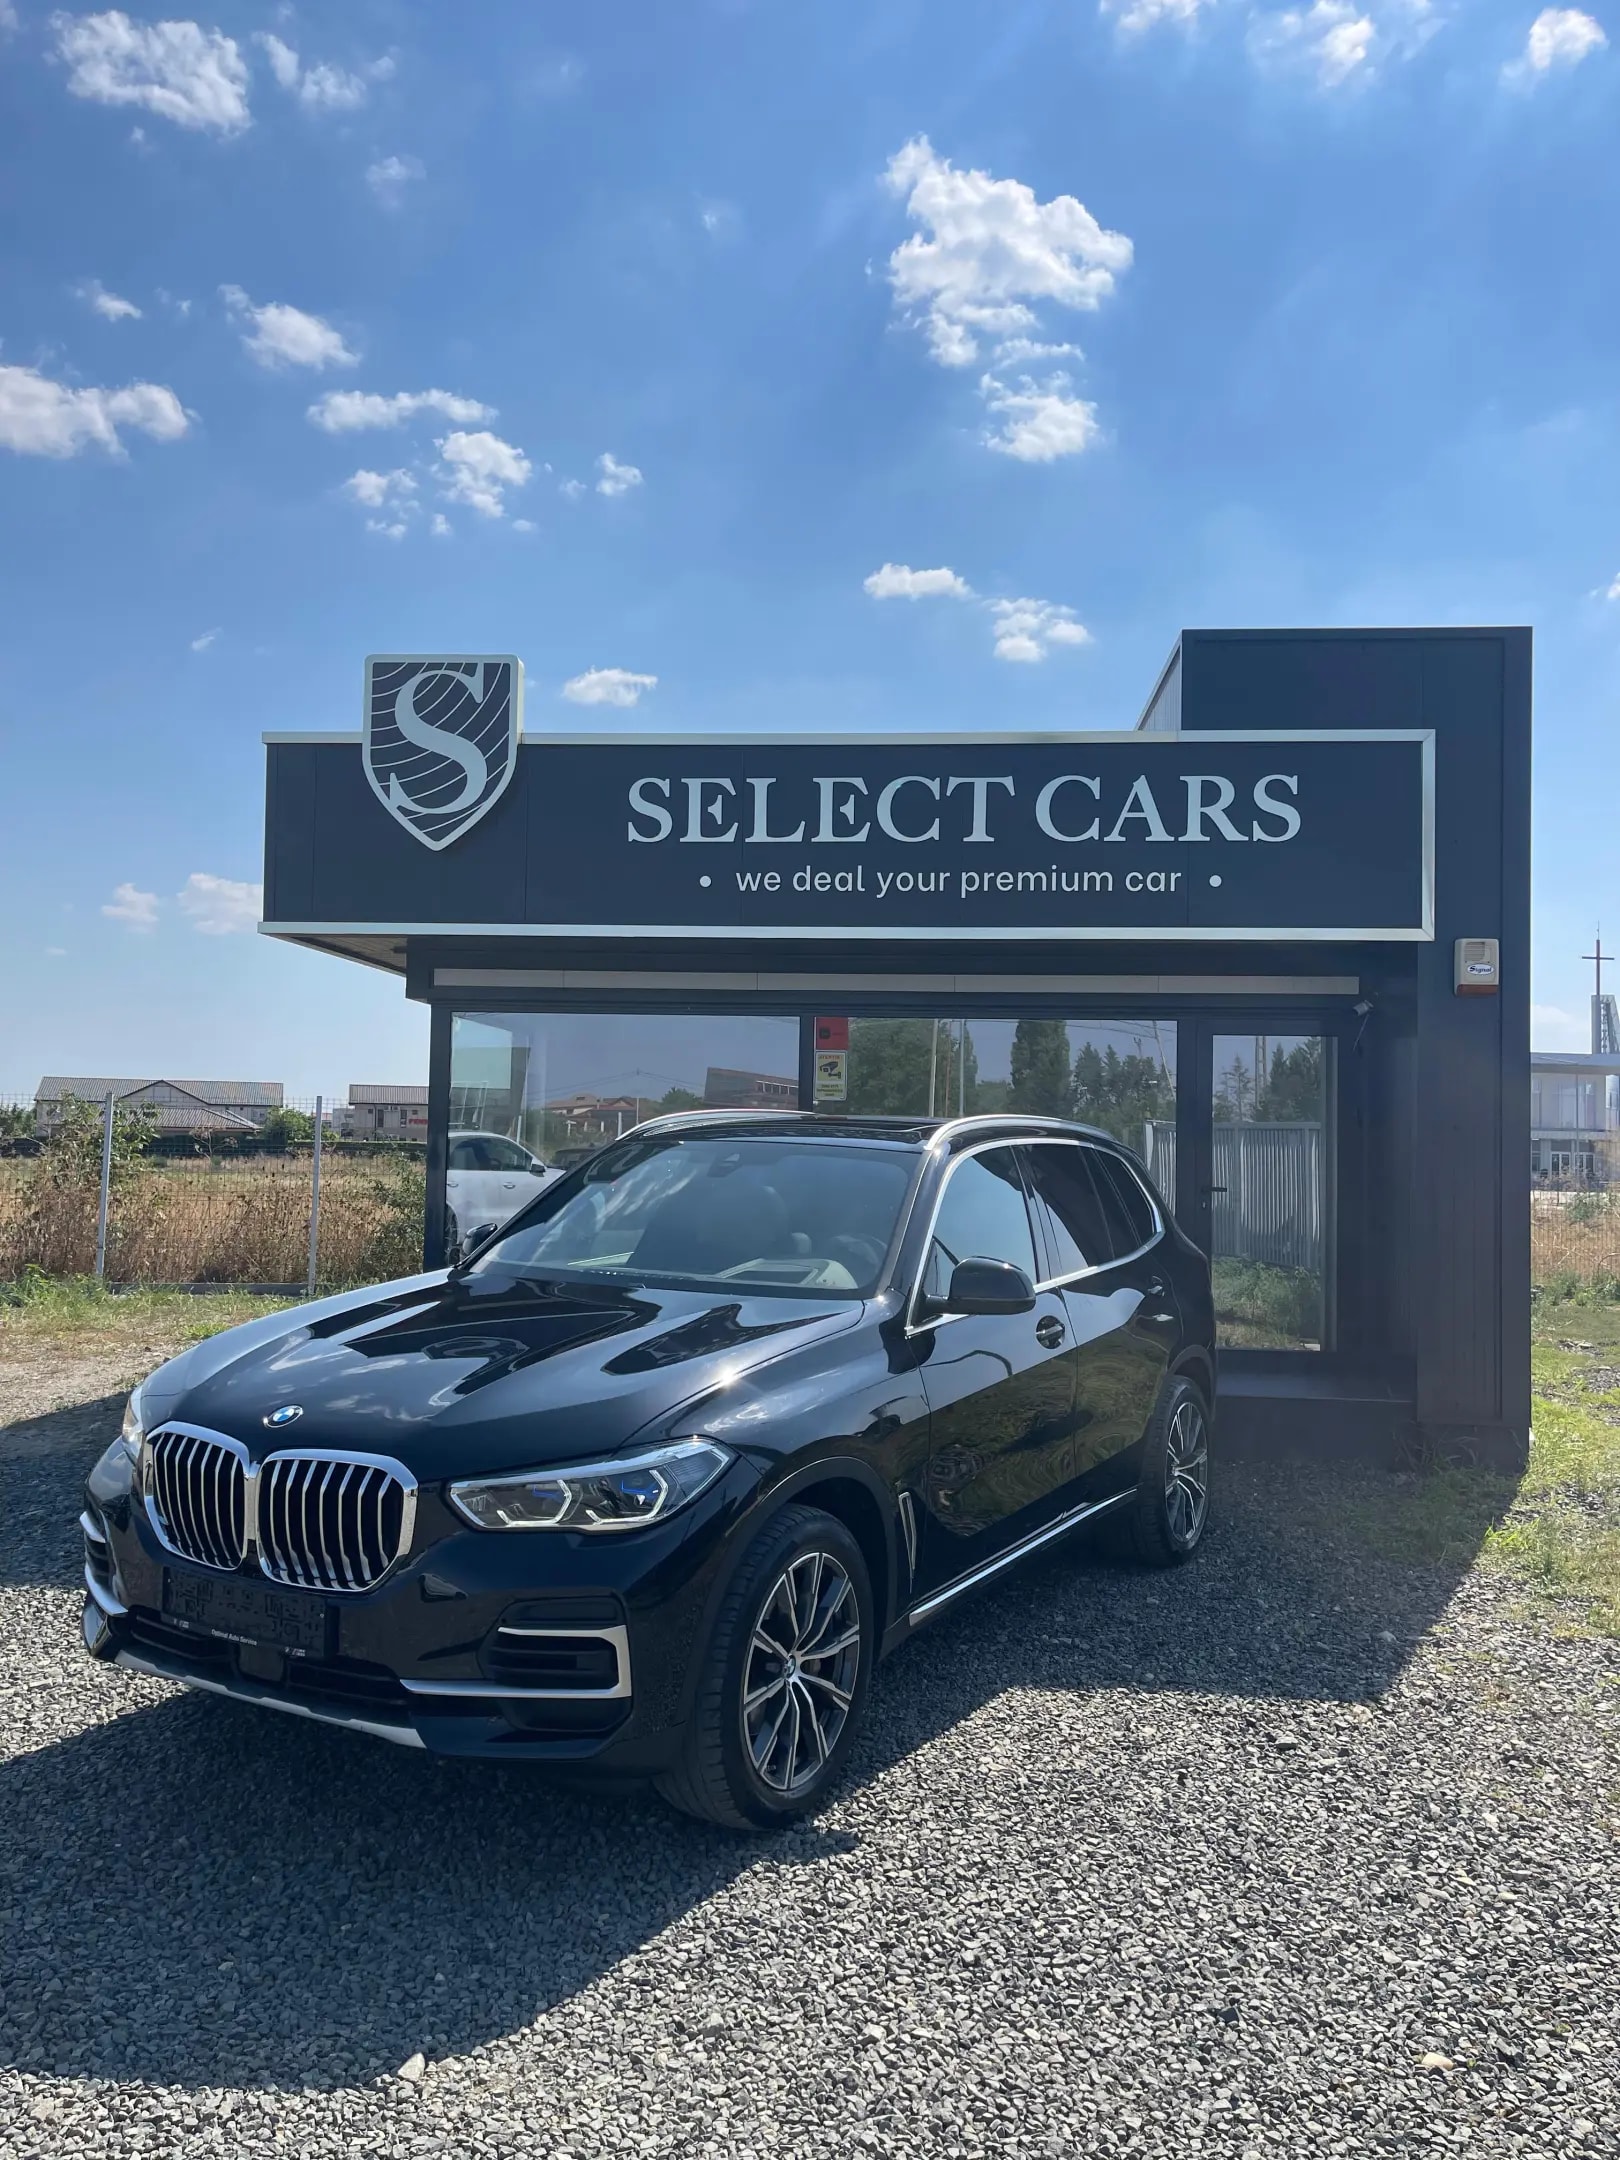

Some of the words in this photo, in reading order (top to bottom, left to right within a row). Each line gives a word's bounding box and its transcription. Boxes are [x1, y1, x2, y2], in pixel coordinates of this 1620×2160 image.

[389, 661, 488, 815] S
[626, 775, 1016, 844] SELECT
[1034, 773, 1302, 843] CARS
[735, 870, 781, 893] we
[792, 864, 867, 893] deal
[875, 870, 952, 899] your
[960, 864, 1114, 899] premium
[1124, 870, 1183, 893] car
